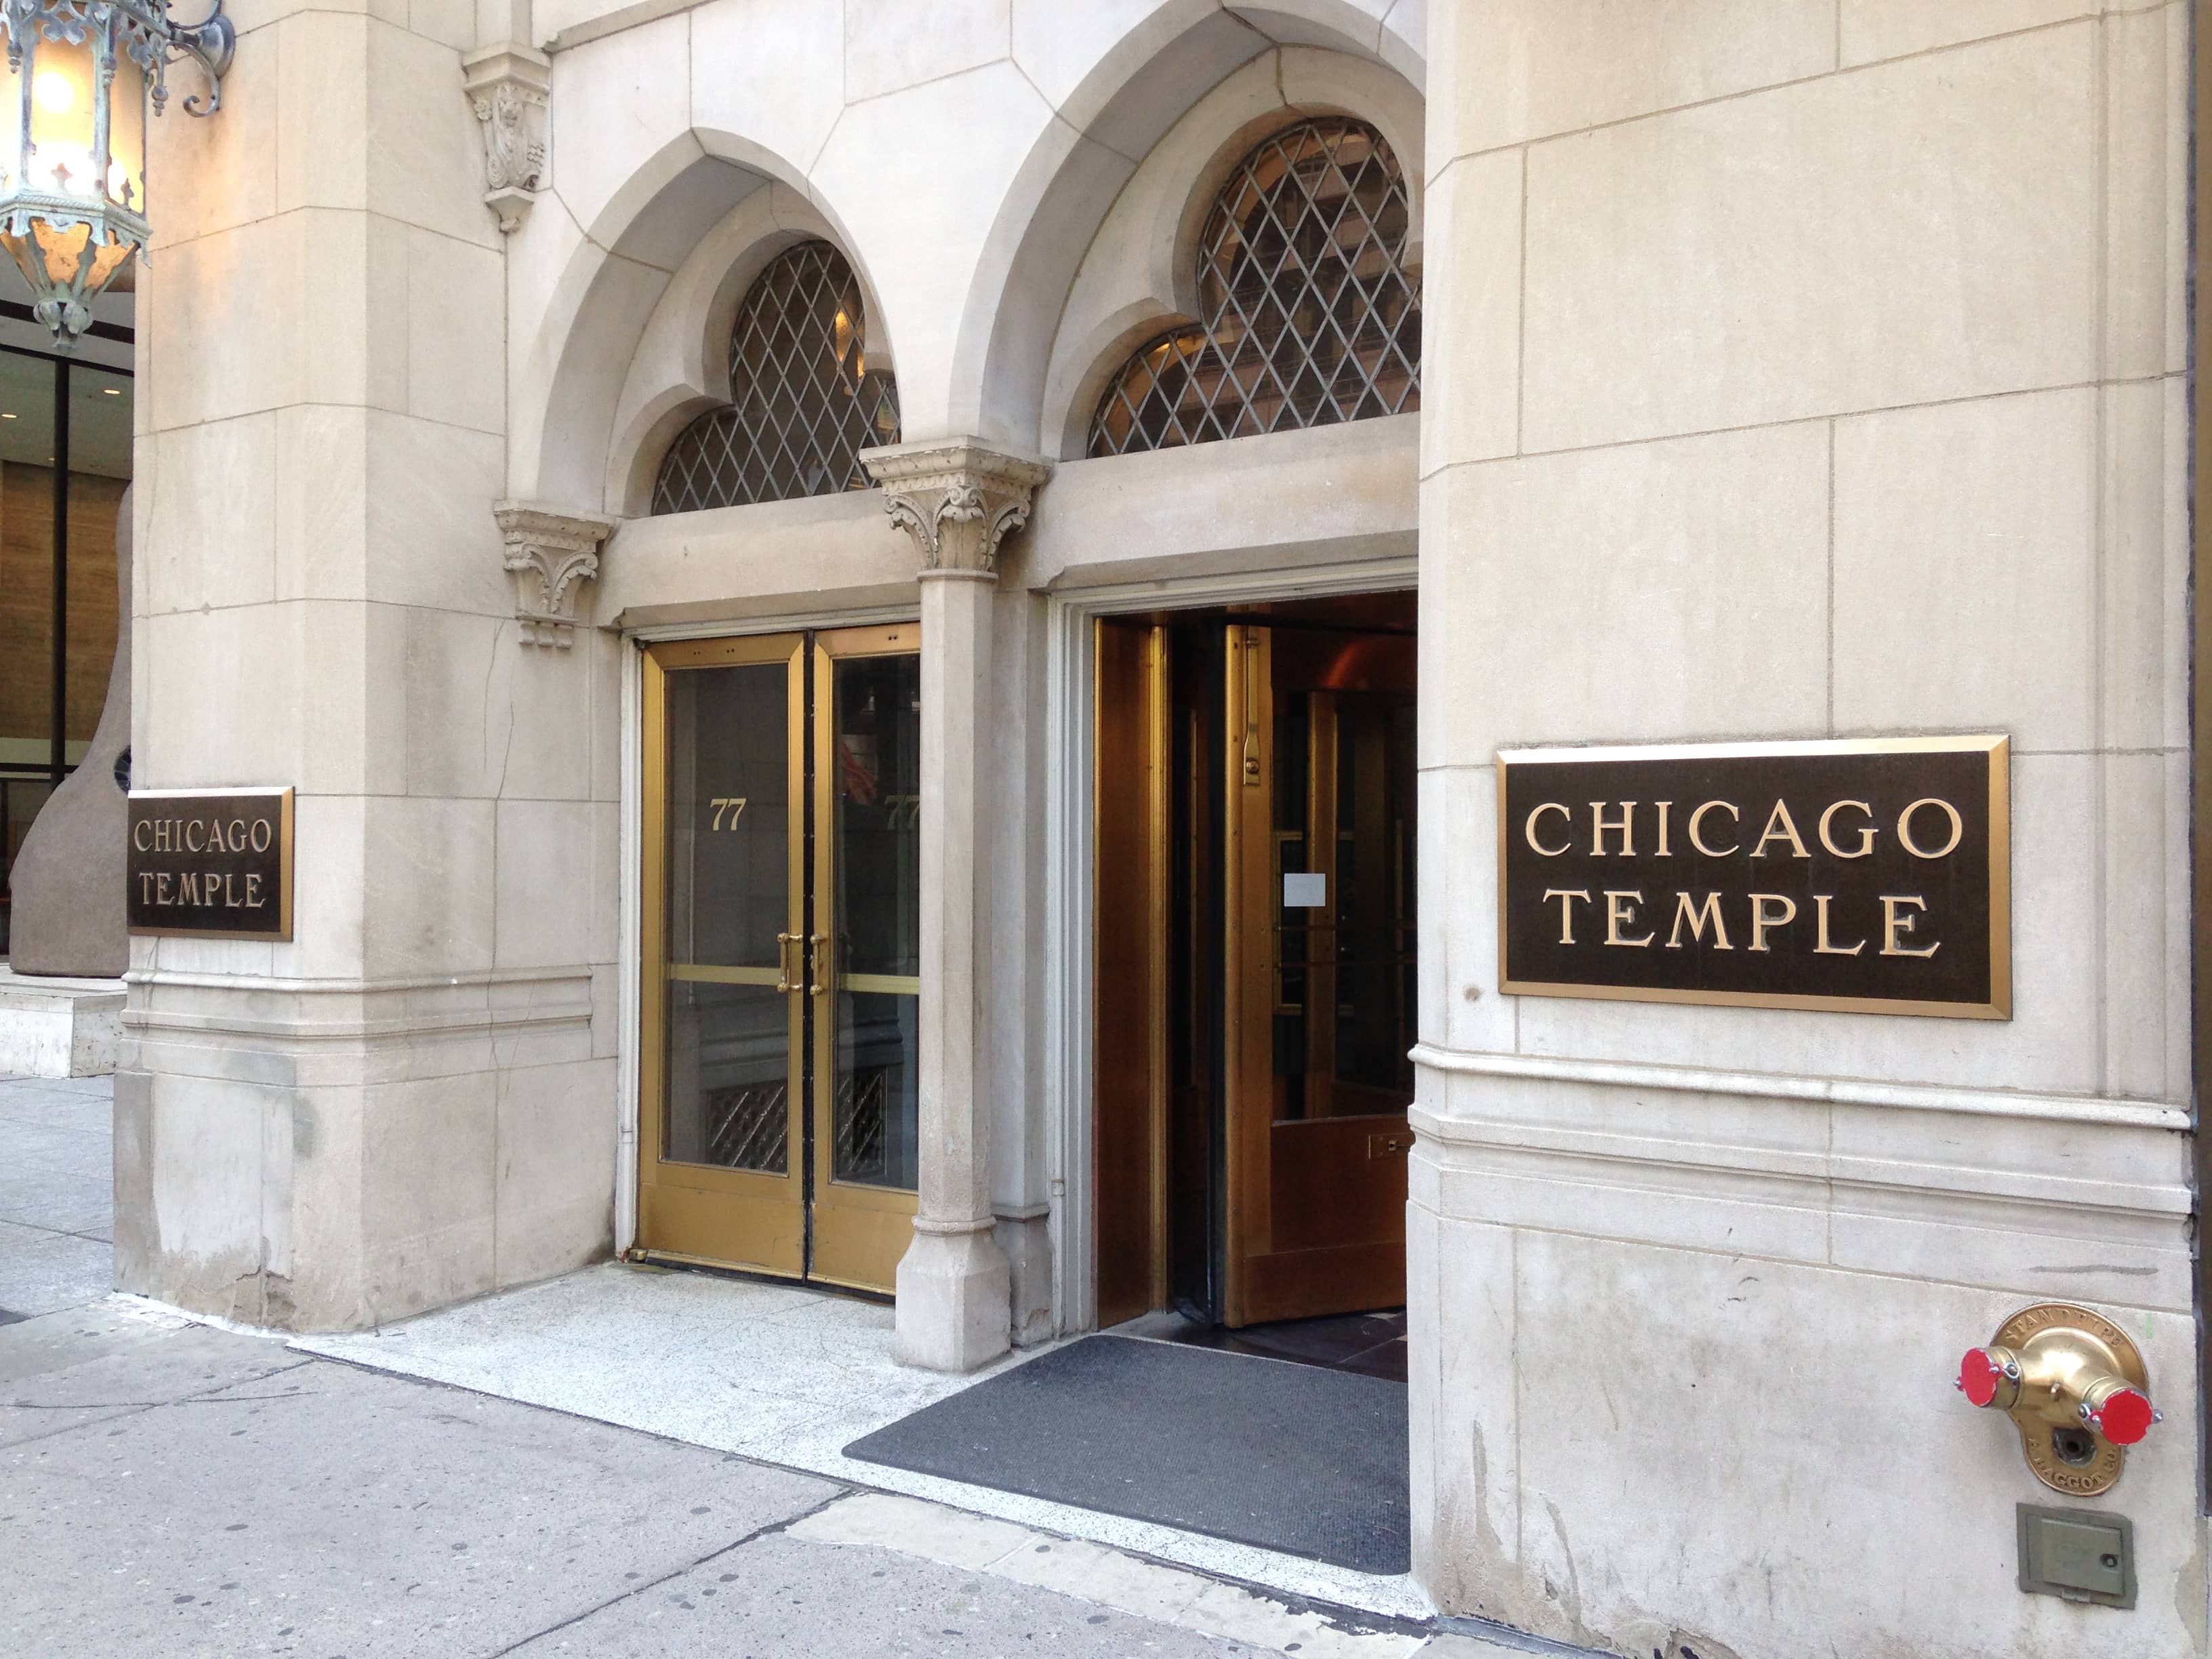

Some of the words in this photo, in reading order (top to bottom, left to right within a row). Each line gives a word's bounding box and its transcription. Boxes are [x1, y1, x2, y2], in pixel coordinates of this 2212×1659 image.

[710, 798, 747, 831] 77
[1525, 798, 1963, 859] CHICAGO
[134, 818, 272, 853] CHICAGO
[139, 872, 266, 909] TEMPLE
[1542, 888, 1942, 959] TEMPLE
